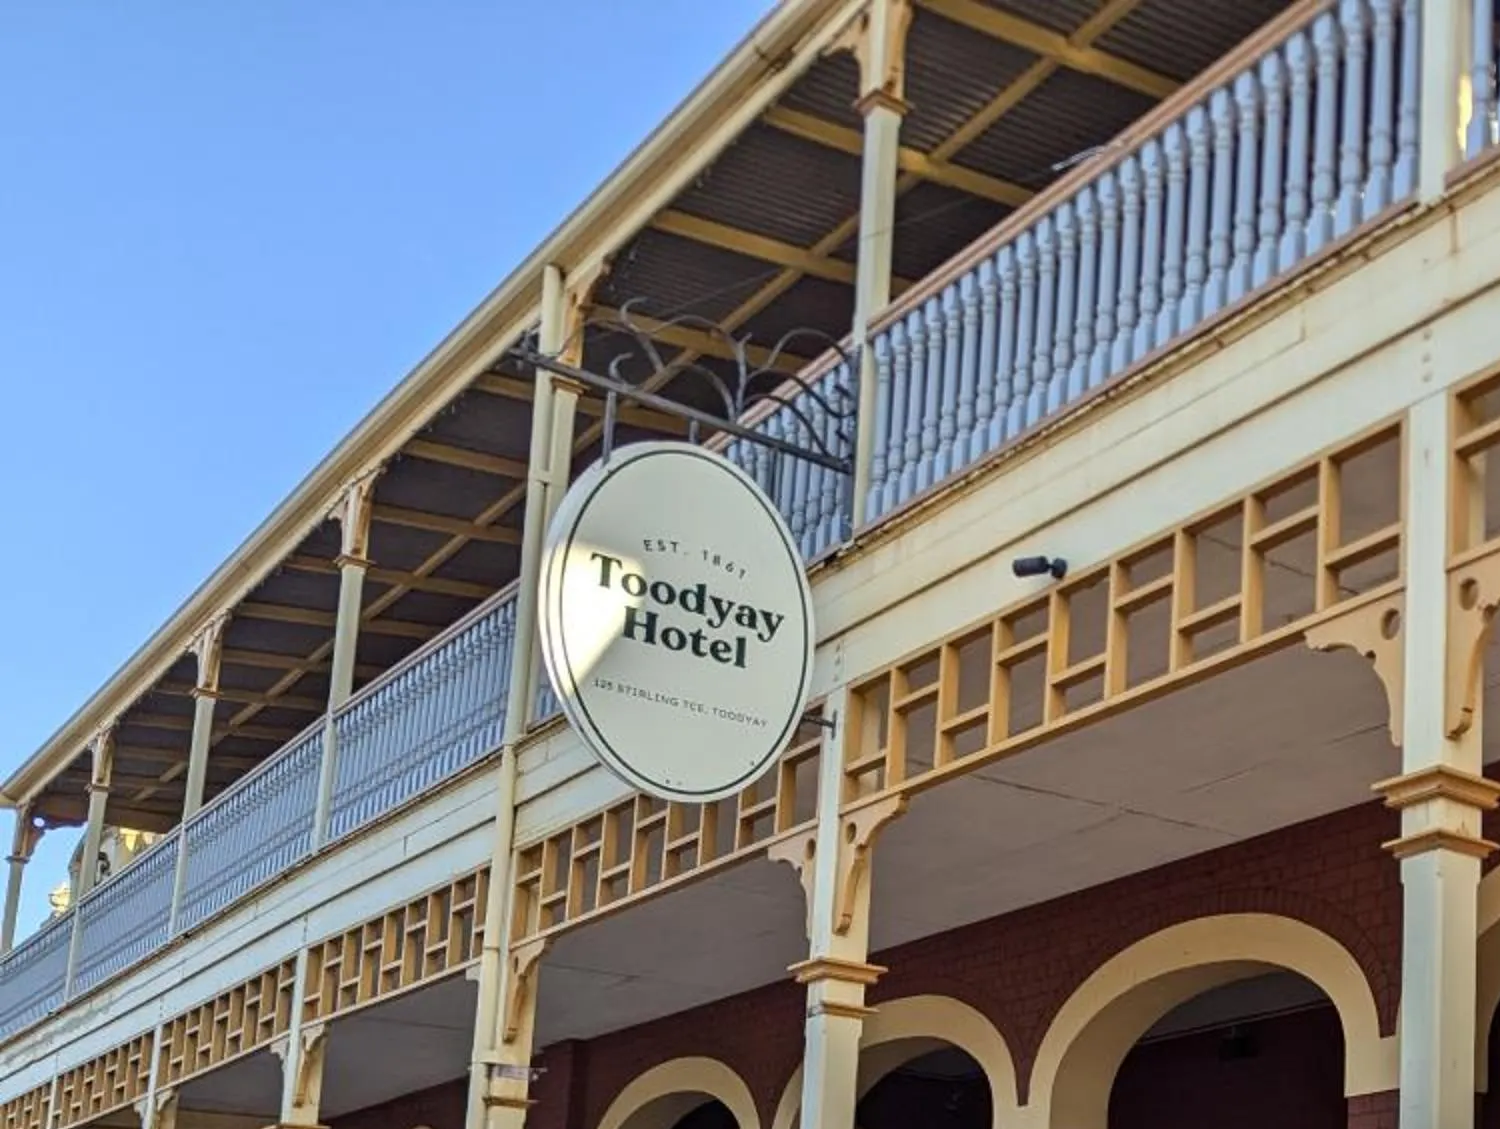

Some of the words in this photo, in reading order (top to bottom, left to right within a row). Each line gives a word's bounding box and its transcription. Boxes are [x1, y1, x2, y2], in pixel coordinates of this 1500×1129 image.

[590, 552, 785, 643] Toodyay
[623, 605, 748, 669] Hotel
[617, 682, 680, 708] STIRLING
[712, 706, 769, 728] TOODYAY
